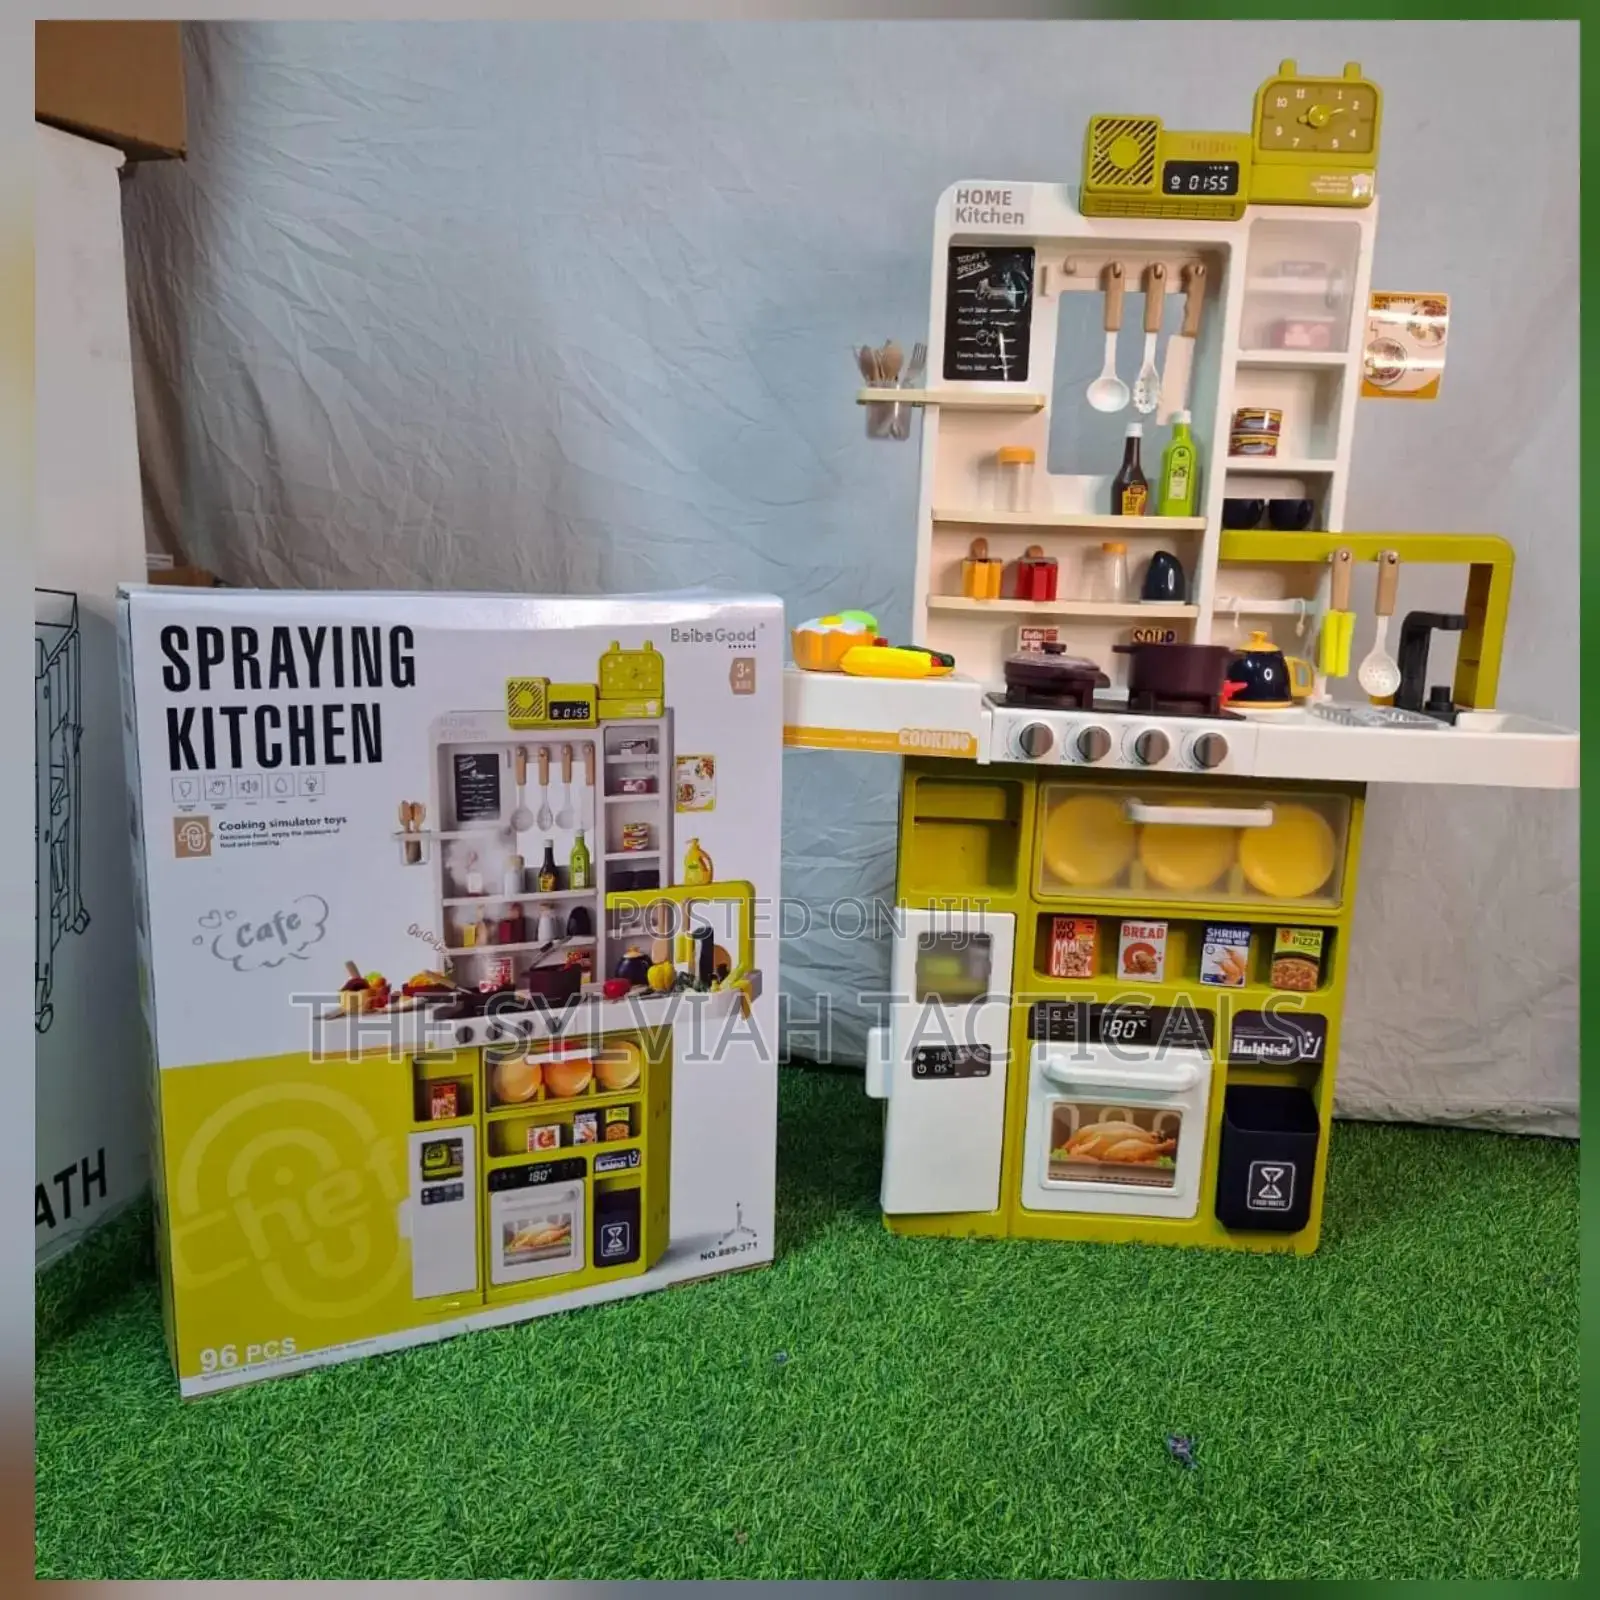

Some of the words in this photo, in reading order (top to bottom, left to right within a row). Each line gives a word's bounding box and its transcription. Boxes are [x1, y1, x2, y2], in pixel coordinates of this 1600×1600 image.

[1276, 97, 1288, 108] 10
[1352, 100, 1360, 110] 2
[1349, 128, 1357, 138] 4
[1292, 137, 1300, 148] 7
[956, 189, 1013, 206] HOME
[955, 207, 1025, 226] Kitchen
[1133, 628, 1176, 643] SOUP
[160, 624, 416, 692] SPRAYING
[166, 703, 383, 771] KITCHEN
[898, 727, 971, 752] COOKING
[218, 820, 266, 831] Cooking
[269, 816, 321, 828] simulator
[324, 815, 348, 826] toys
[235, 909, 302, 948] Cafe
[1055, 920, 1076, 930] WO
[1122, 924, 1165, 940] BREAD
[1206, 927, 1250, 939] SHRIMP
[1055, 930, 1076, 940] WO
[1292, 936, 1320, 946] PIZZA
[1232, 1037, 1292, 1056] Rubbish
[200, 1343, 239, 1373] 96
[245, 1336, 297, 1363] PCS
